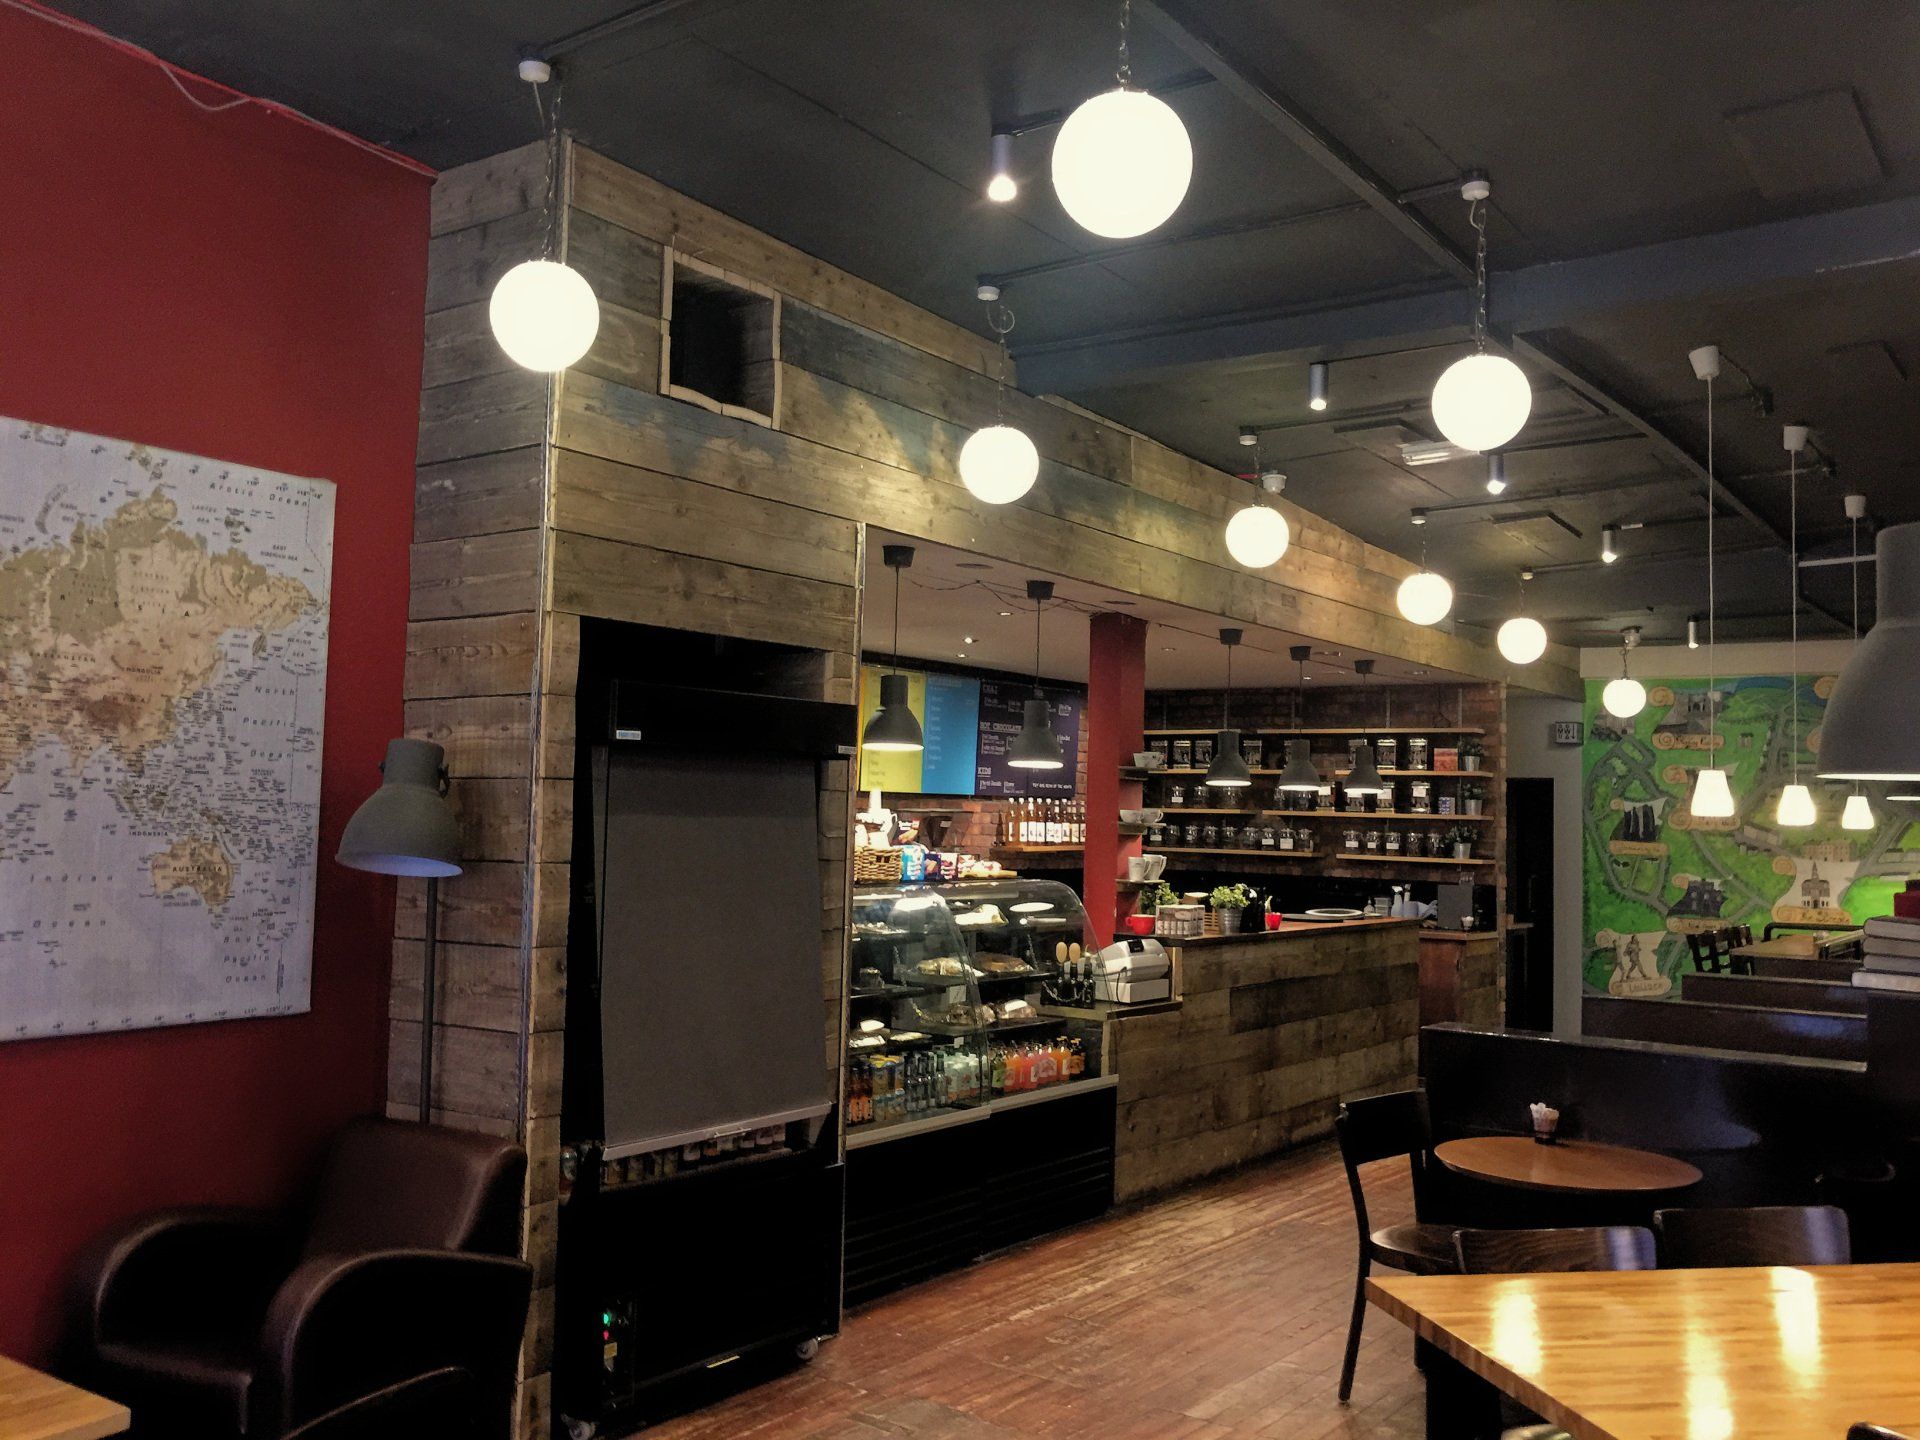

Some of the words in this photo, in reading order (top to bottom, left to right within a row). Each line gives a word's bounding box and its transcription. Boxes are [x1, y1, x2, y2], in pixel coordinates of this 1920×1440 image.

[210, 482, 253, 497] Arctic
[269, 493, 307, 507] Ocean
[126, 667, 161, 675] MONGOLIA
[255, 686, 295, 696] North
[243, 717, 295, 727] Pacific
[980, 721, 991, 729] HOT
[992, 723, 1023, 731] CHOCOLATE
[250, 749, 293, 758] Ocean
[31, 873, 113, 883] Indian
[33, 919, 106, 928] Ocean
[225, 974, 266, 983] Ocean
